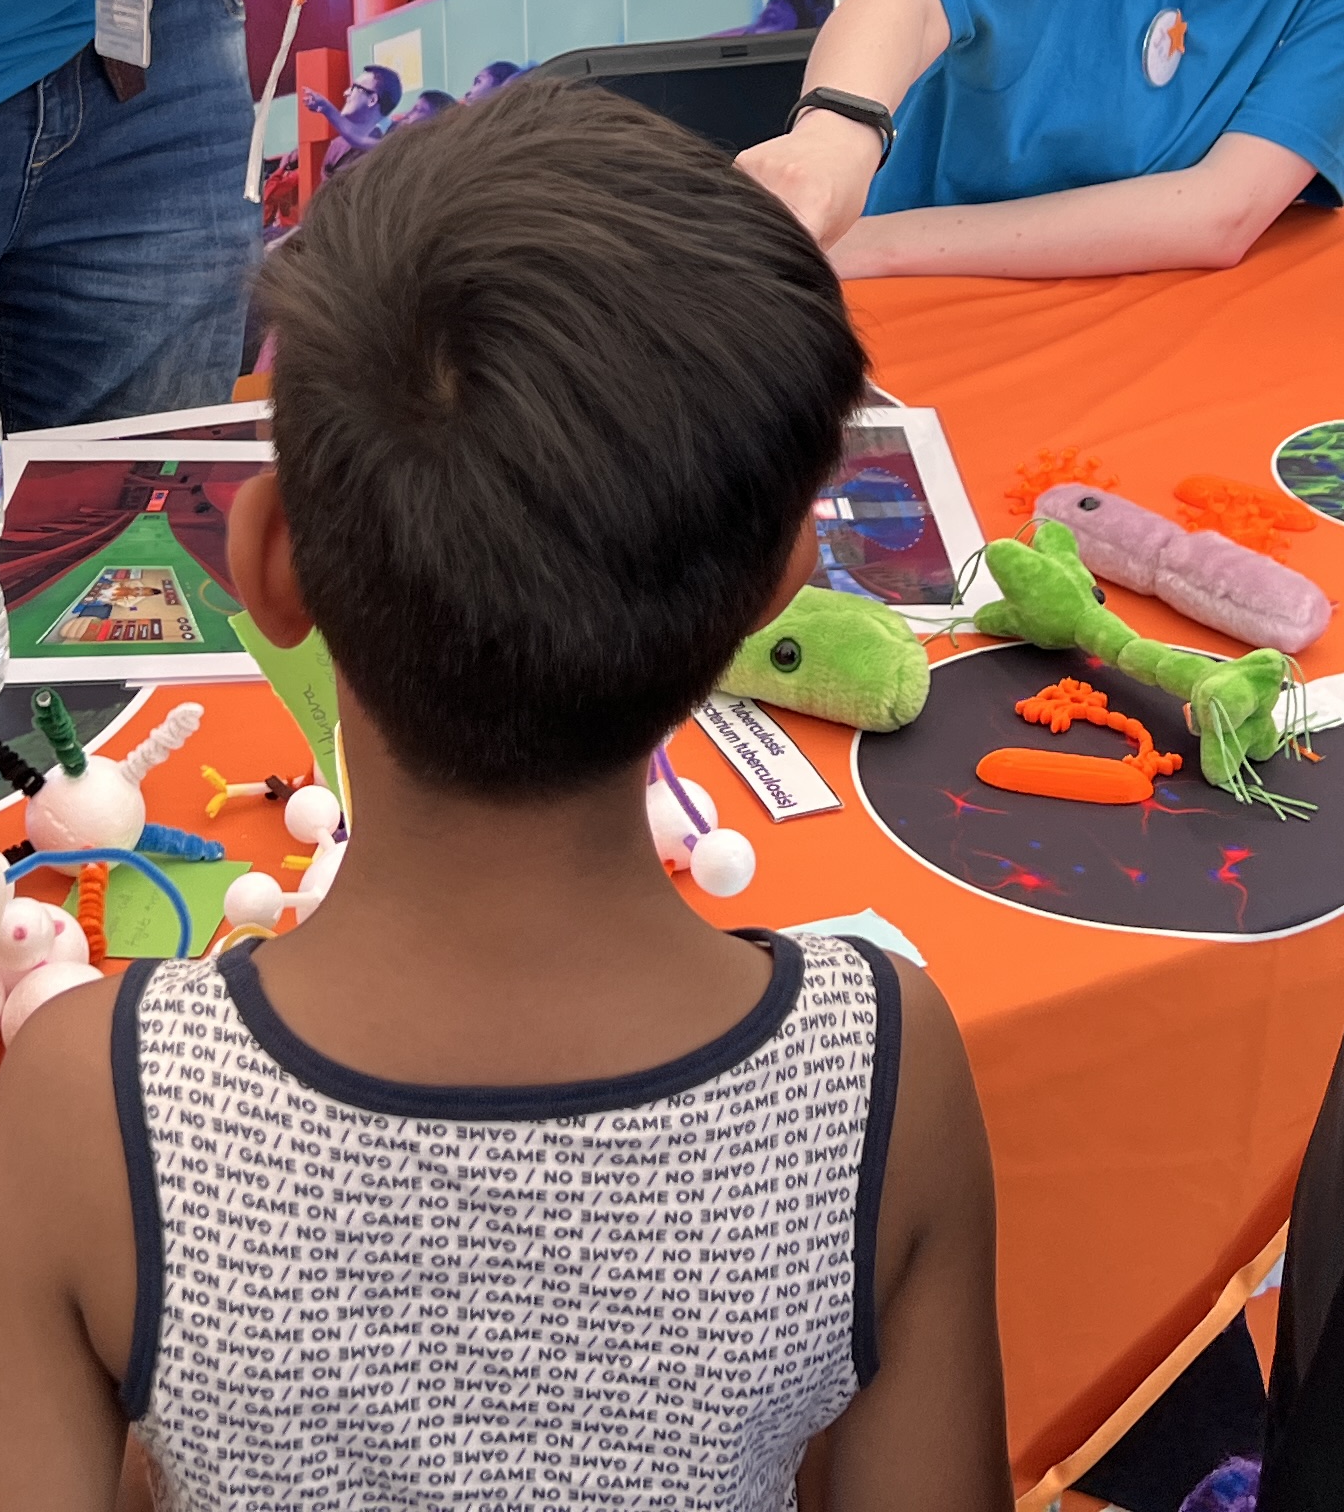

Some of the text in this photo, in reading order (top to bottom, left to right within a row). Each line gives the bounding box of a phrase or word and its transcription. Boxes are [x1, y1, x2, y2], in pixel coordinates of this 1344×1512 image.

[728, 701, 786, 757] Tuberculosis
[733, 742, 798, 809] tuberculosis)
[179, 1109, 756, 1187] GAME ON GAME ON GAME ON GAME ON GAME ON
[188, 1089, 707, 1167] ON GAME ON GAME ON GAME ON GAME ON
[180, 1155, 755, 1226] GAME ON GAME ON GAME ON GAME ON GAME ON
[190, 1134, 705, 1205] ON GAME ON GAME ON GAME ON GAME ON
[192, 1180, 584, 1241] ON GAME ON GAME ON GAME ON
